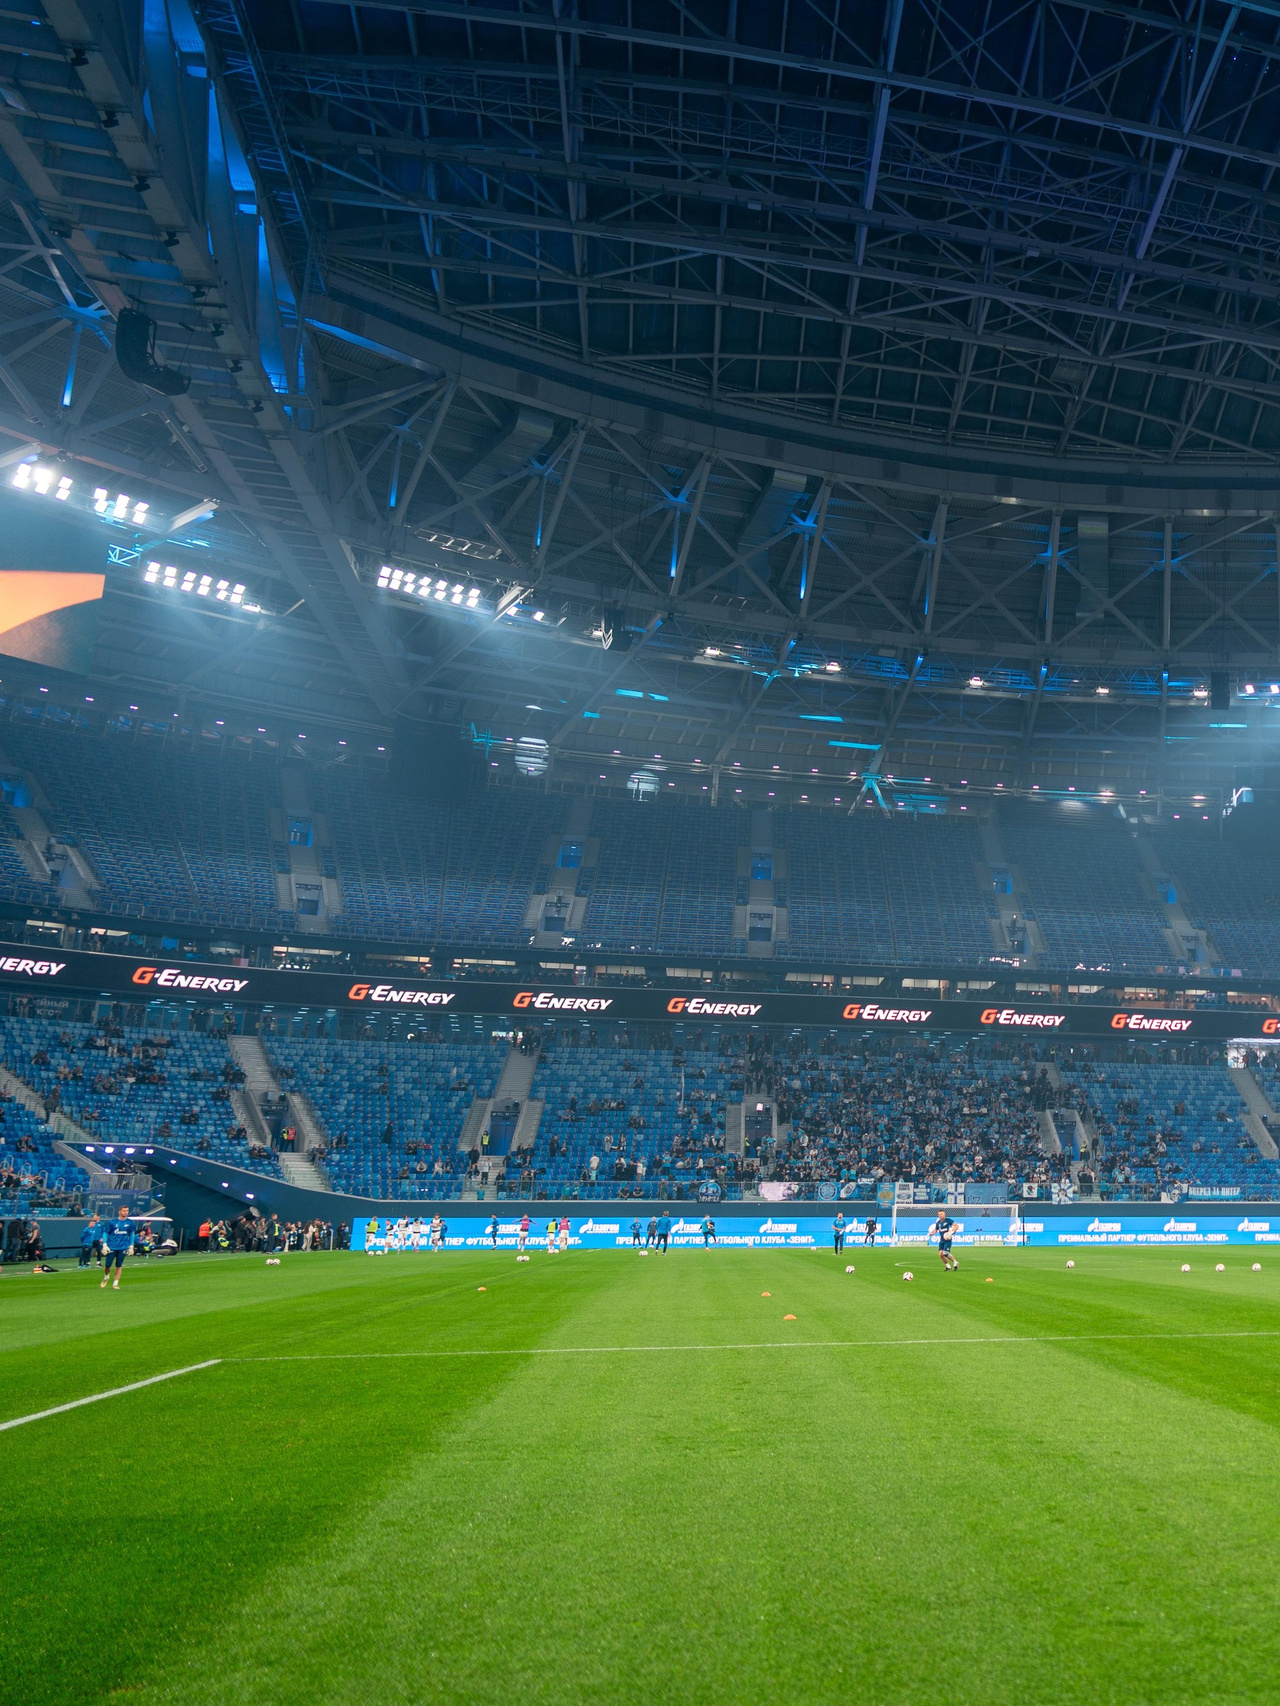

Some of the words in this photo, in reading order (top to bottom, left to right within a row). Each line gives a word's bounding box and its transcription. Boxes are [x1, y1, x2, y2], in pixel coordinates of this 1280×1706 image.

[761, 1236, 786, 1244] КЛУБА
[1108, 1234, 1136, 1242] ПАРТНЕР
[1183, 1234, 1204, 1242] КЛУБА
